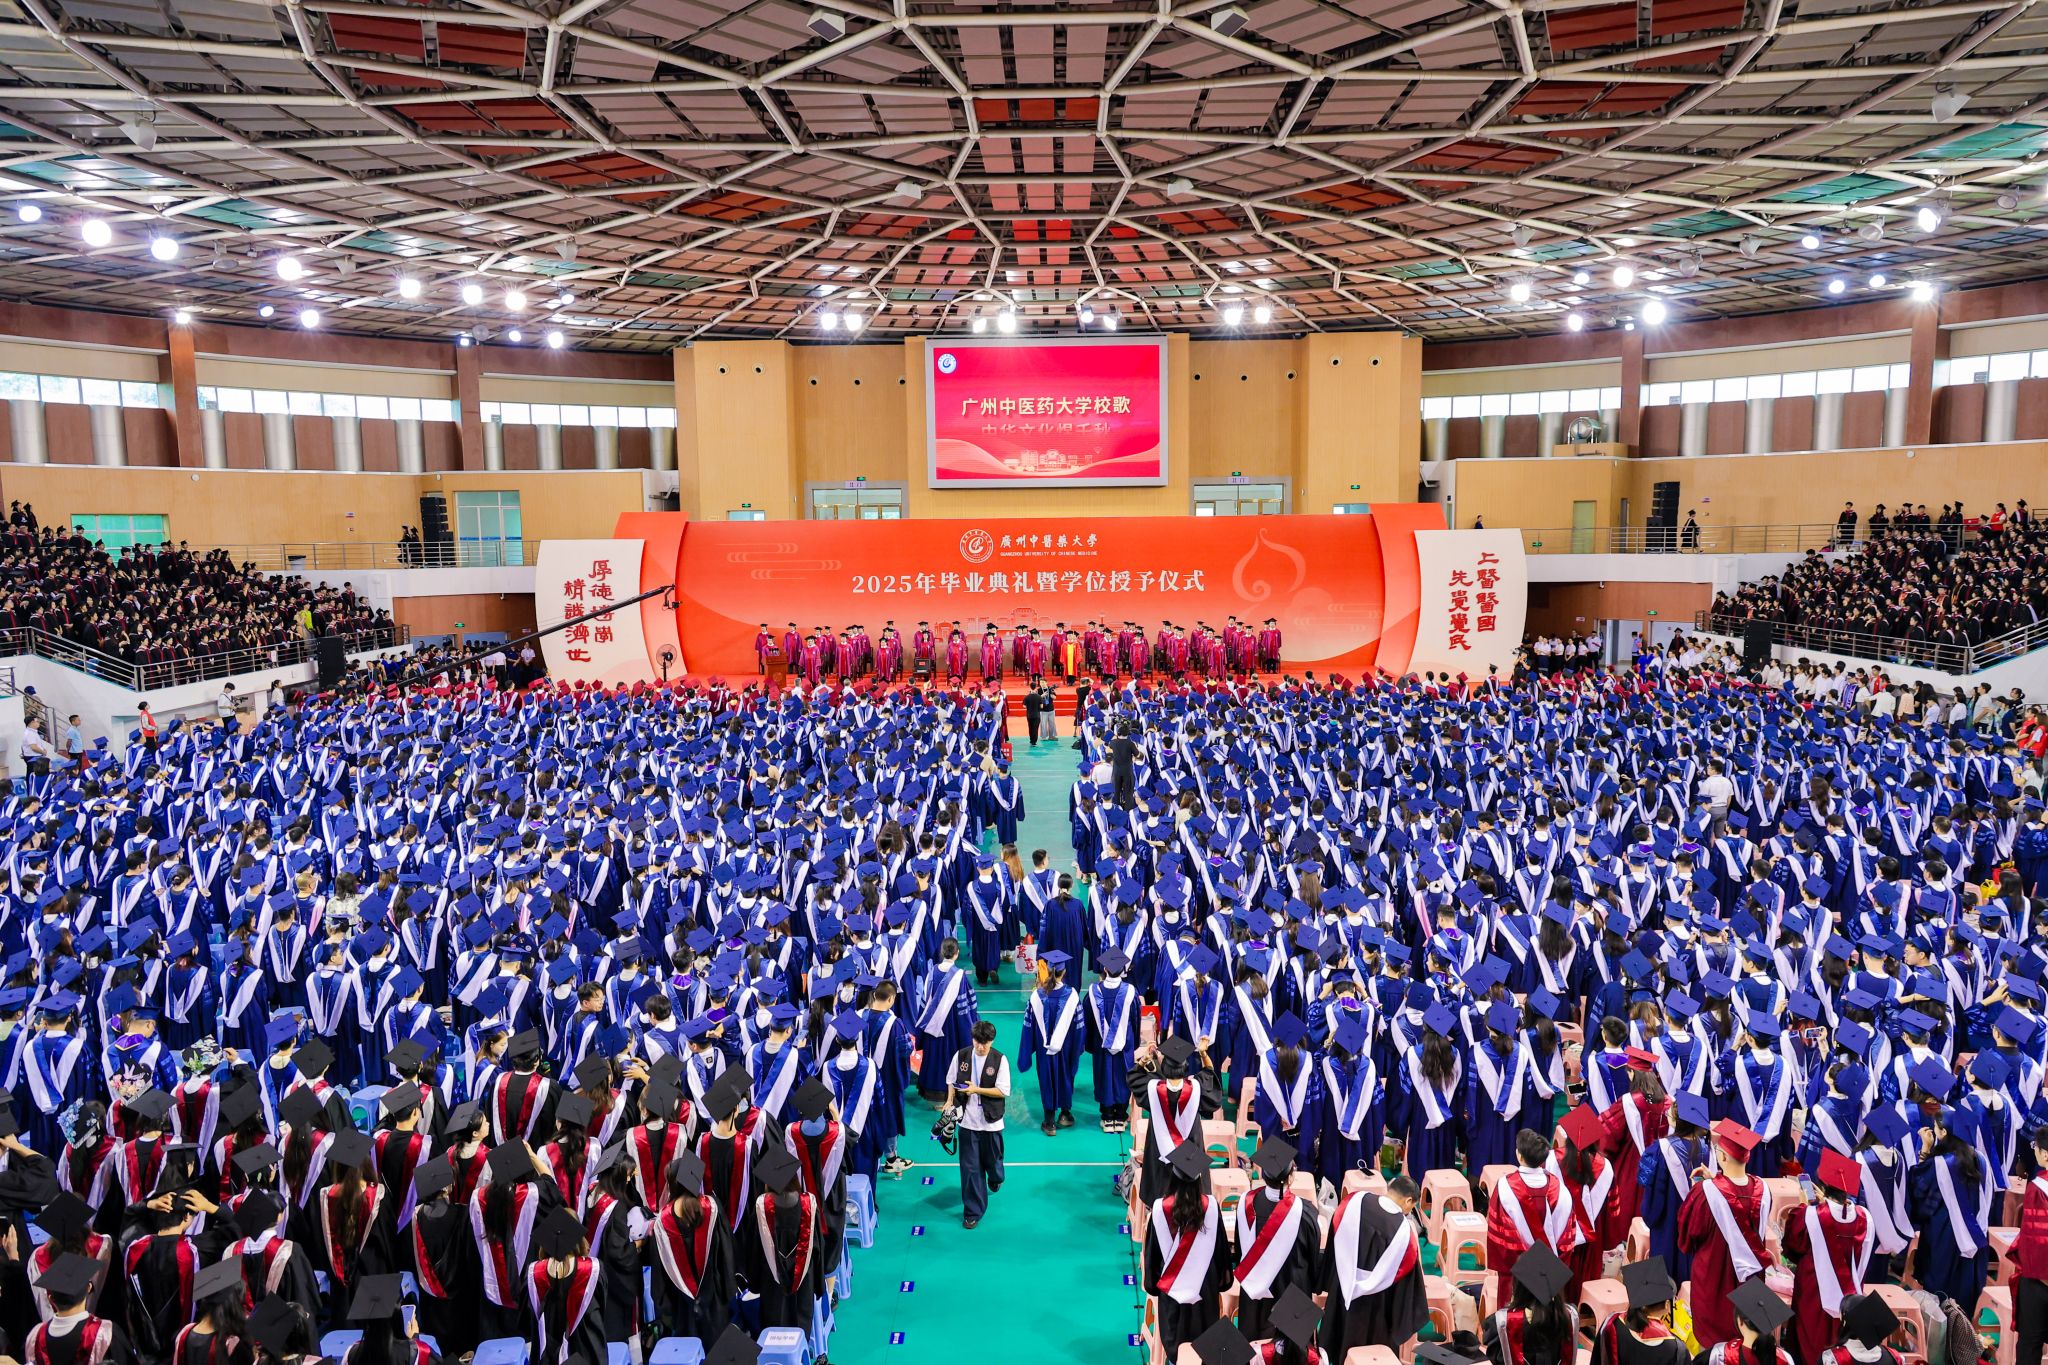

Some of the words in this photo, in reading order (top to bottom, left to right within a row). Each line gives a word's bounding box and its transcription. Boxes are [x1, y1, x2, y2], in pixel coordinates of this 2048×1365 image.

[961, 396, 1131, 416] 广州中医药大学校歌
[852, 570, 1205, 594] 2025年毕业典礼暨学位授予仪式
